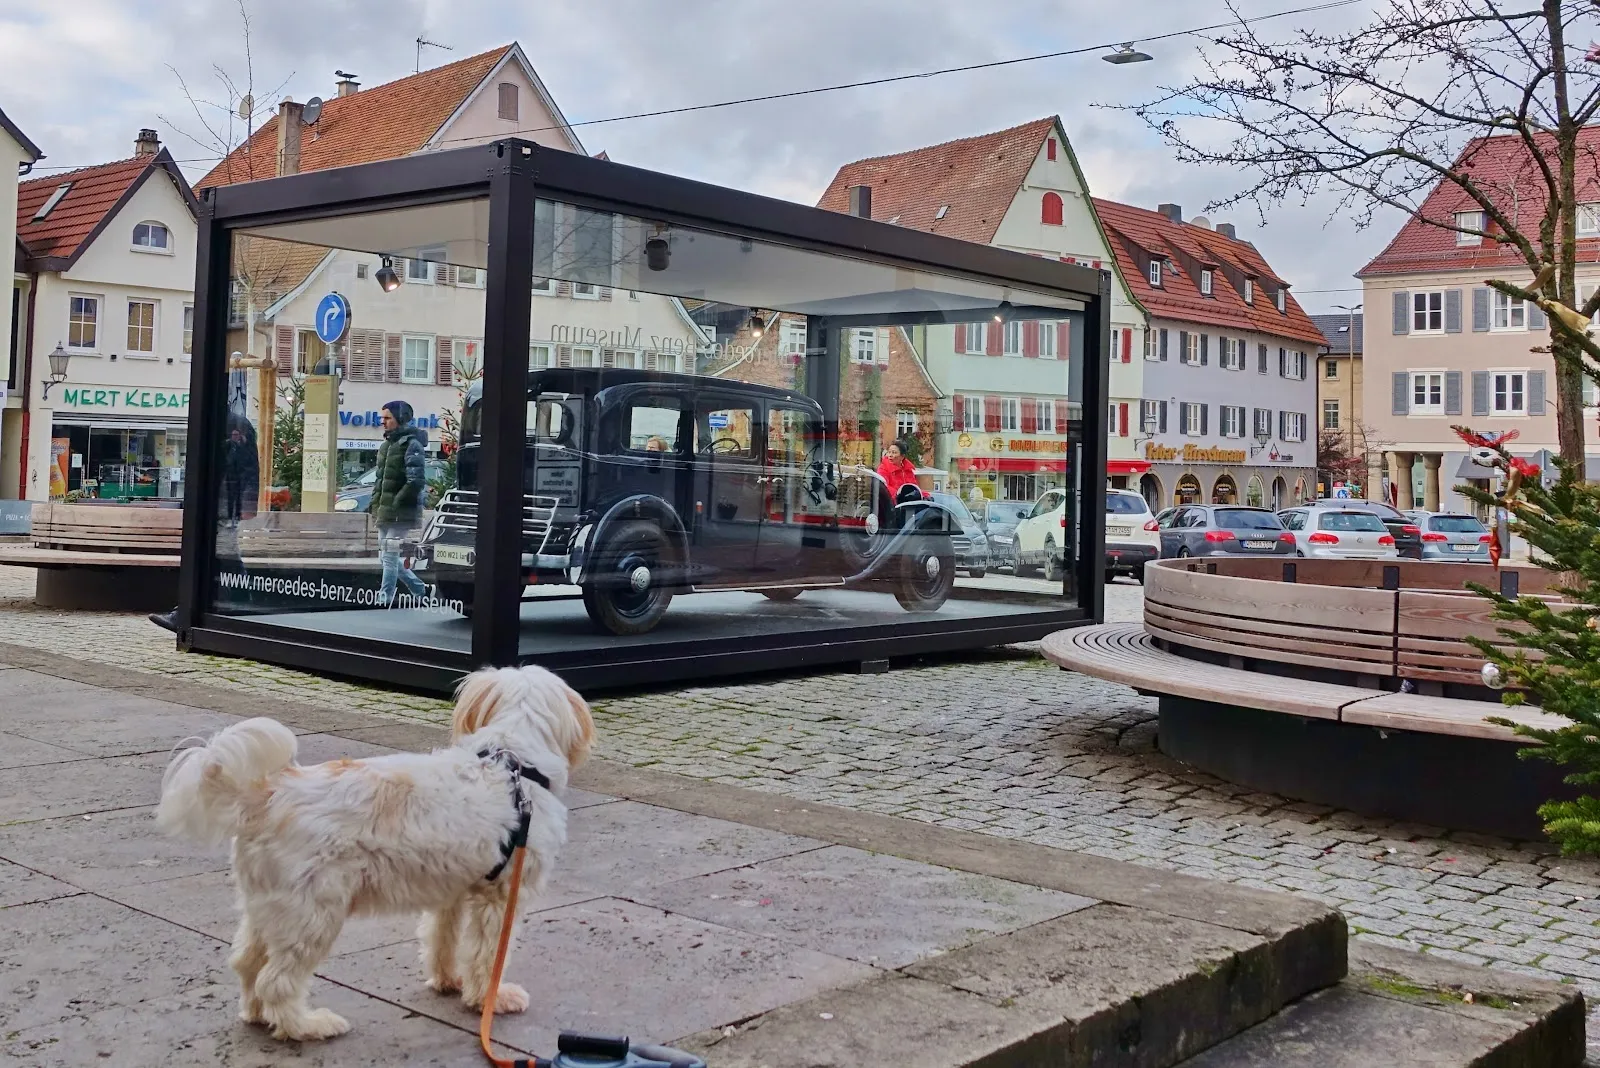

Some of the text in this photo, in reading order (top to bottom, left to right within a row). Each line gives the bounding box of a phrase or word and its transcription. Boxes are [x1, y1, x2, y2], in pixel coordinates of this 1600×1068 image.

[64, 389, 120, 407] MERT
[436, 550, 447, 558] 200
[220, 571, 464, 616] www.mercedes-benz.com/museum
